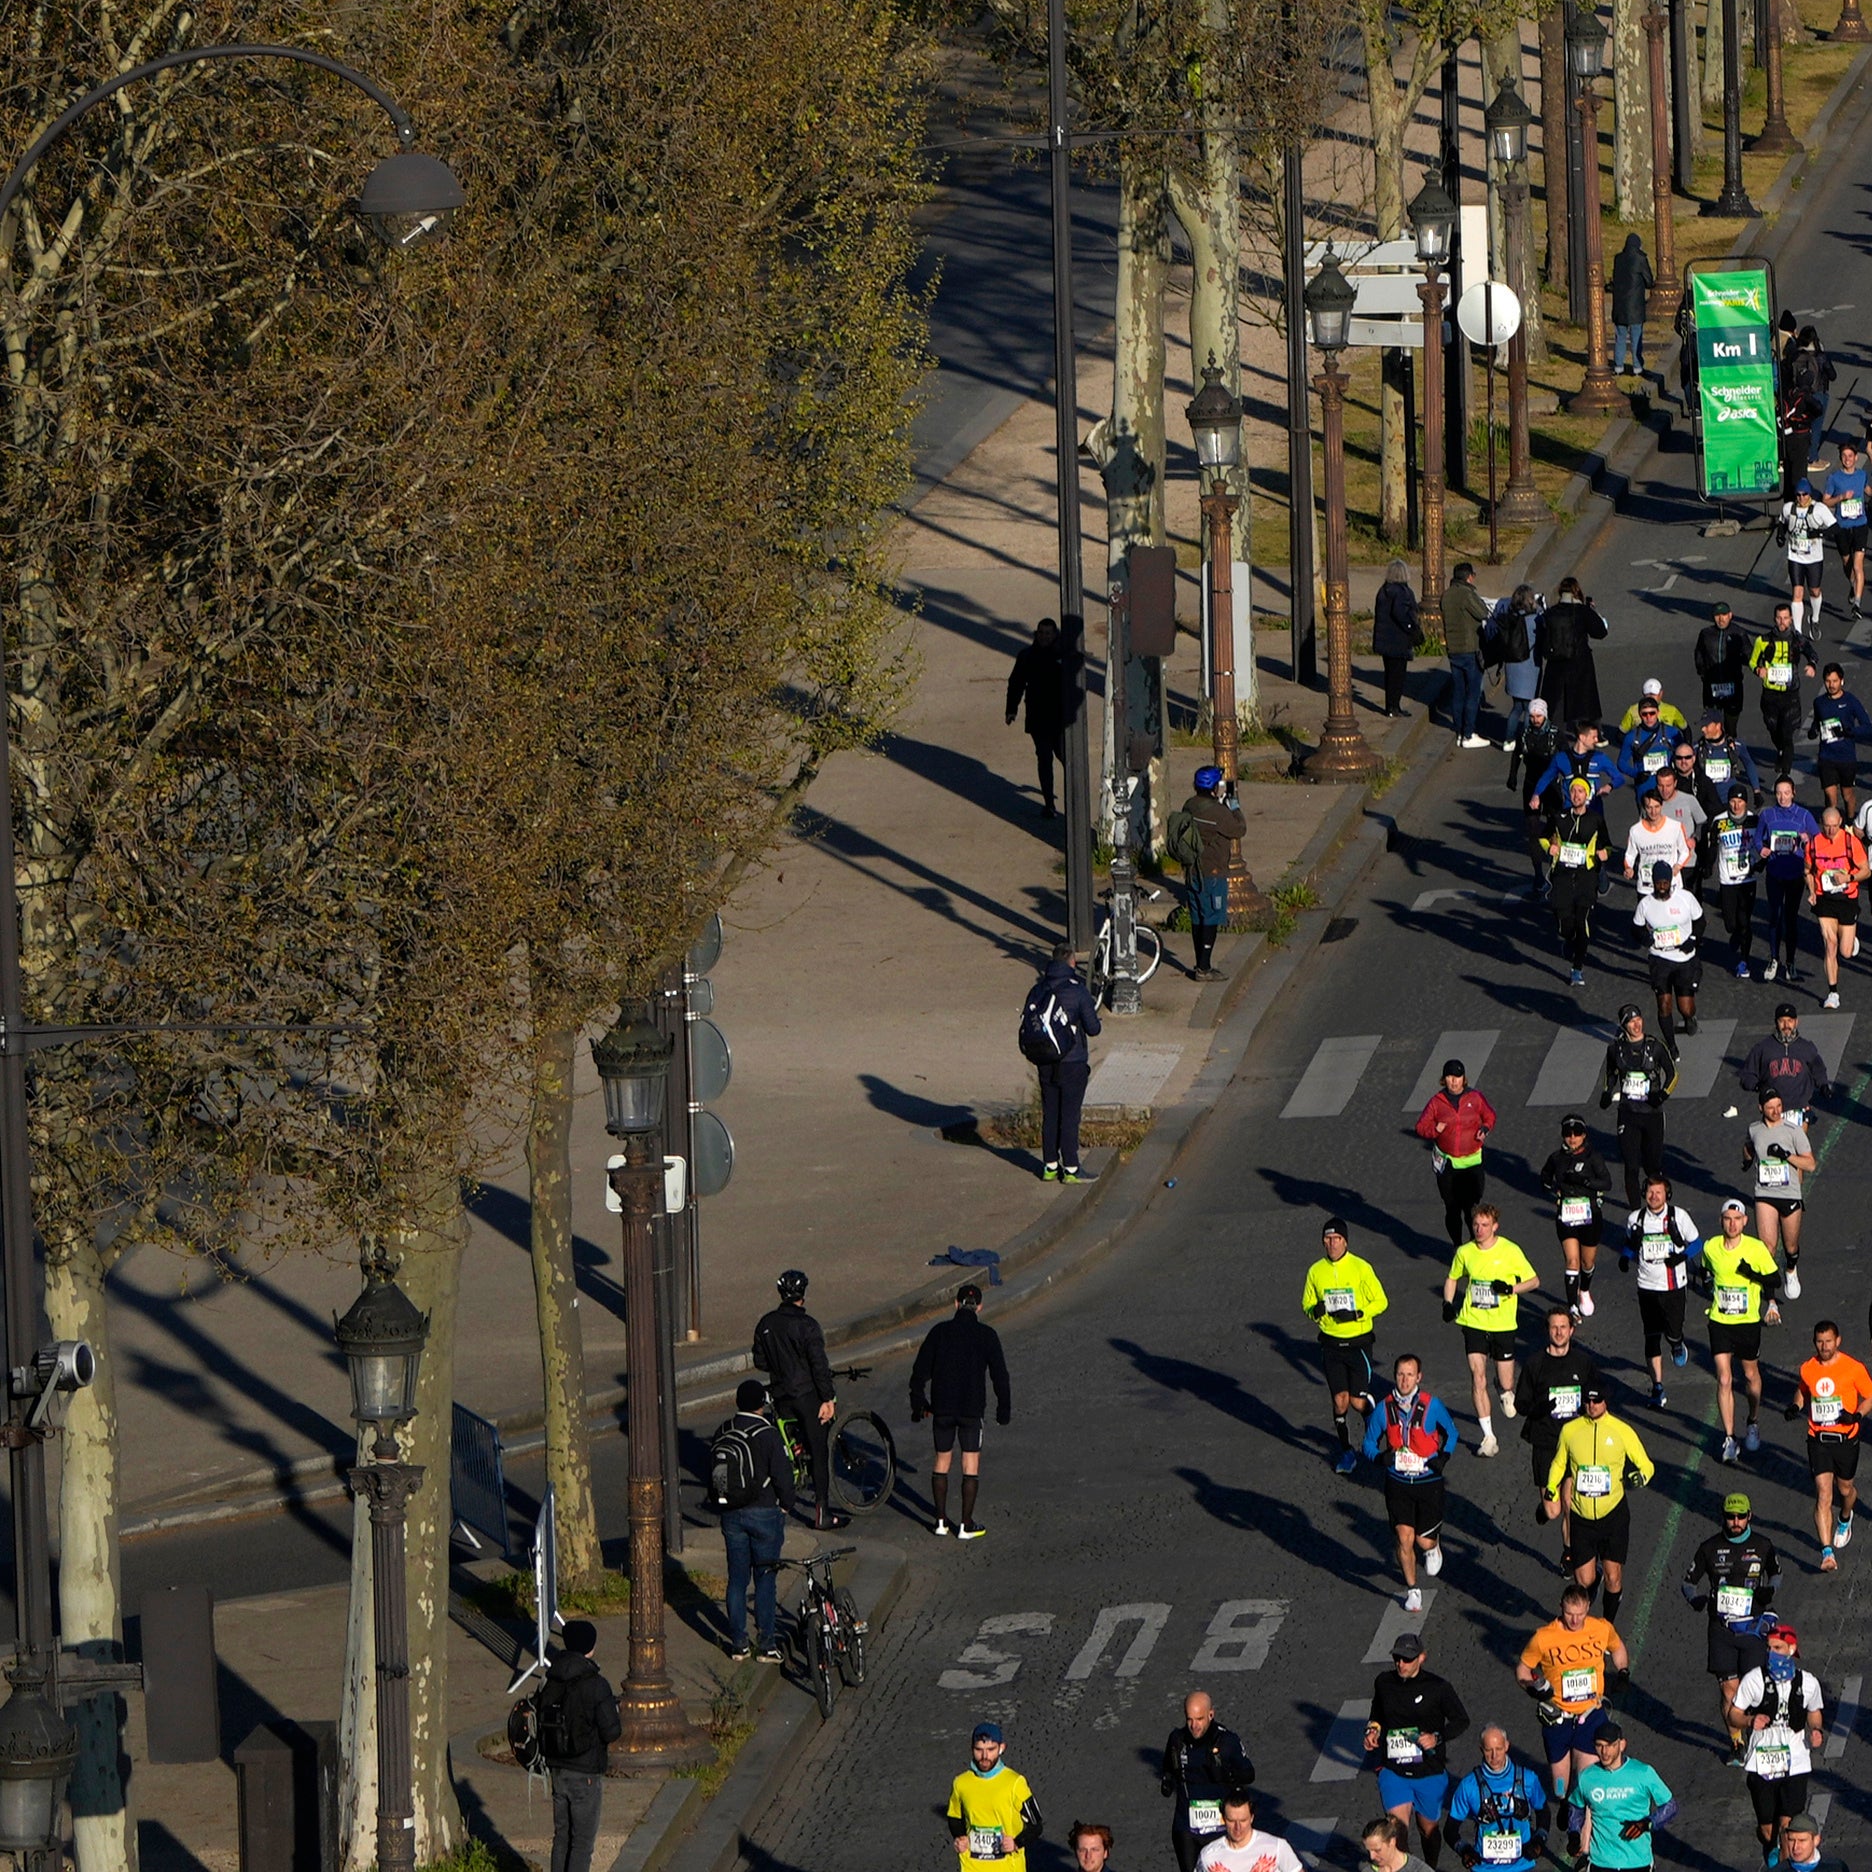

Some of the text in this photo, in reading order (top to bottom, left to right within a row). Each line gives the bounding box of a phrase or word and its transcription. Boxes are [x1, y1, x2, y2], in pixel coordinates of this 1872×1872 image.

[1713, 342, 1741, 358] Km
[1711, 385, 1761, 398] Schneider
[1730, 408, 1757, 419] asics
[1770, 1058, 1802, 1077] GAP
[937, 1598, 1293, 1690] BUS
[1549, 1637, 1604, 1667] ROSS
[1487, 1839, 1514, 1850] 23299
